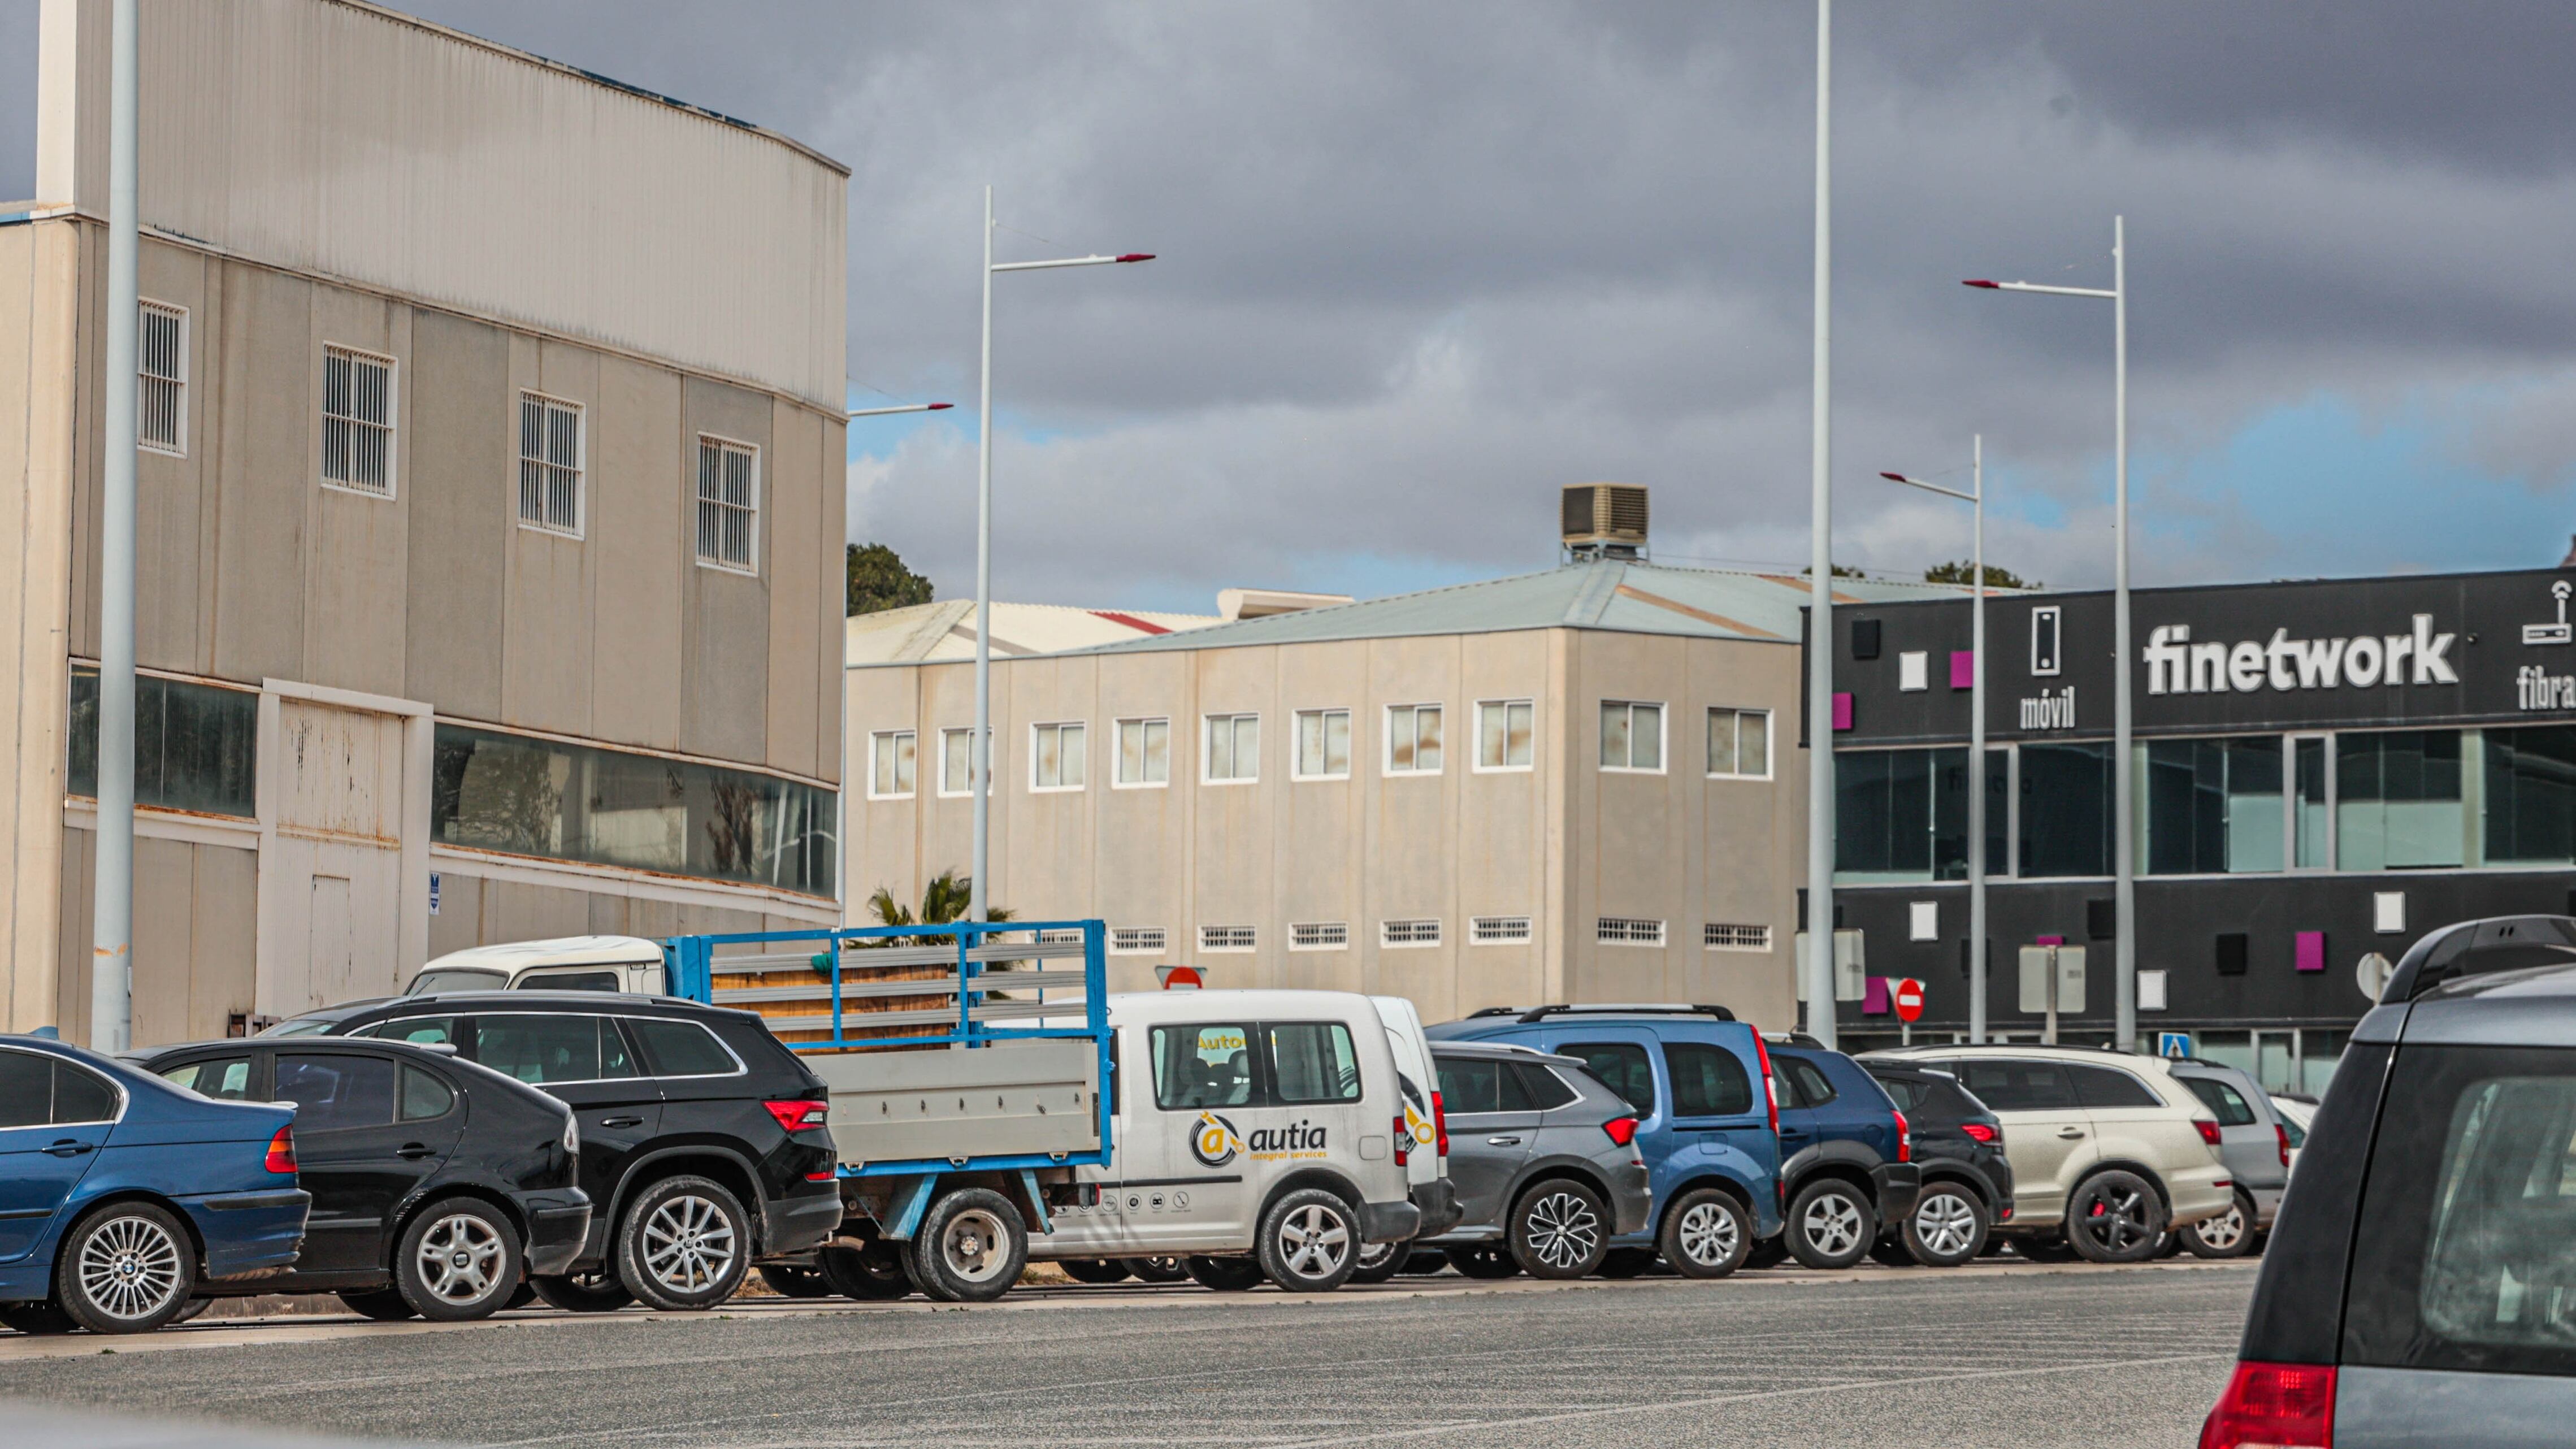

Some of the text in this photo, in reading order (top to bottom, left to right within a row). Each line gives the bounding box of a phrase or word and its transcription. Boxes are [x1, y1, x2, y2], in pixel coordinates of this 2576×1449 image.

[2143, 614, 2459, 694] finetwork
[2020, 686, 2075, 730] móvil
[2516, 665, 2576, 709] fibra
[1248, 1119, 1327, 1151] autia
[1250, 1151, 1327, 1162] integral services
